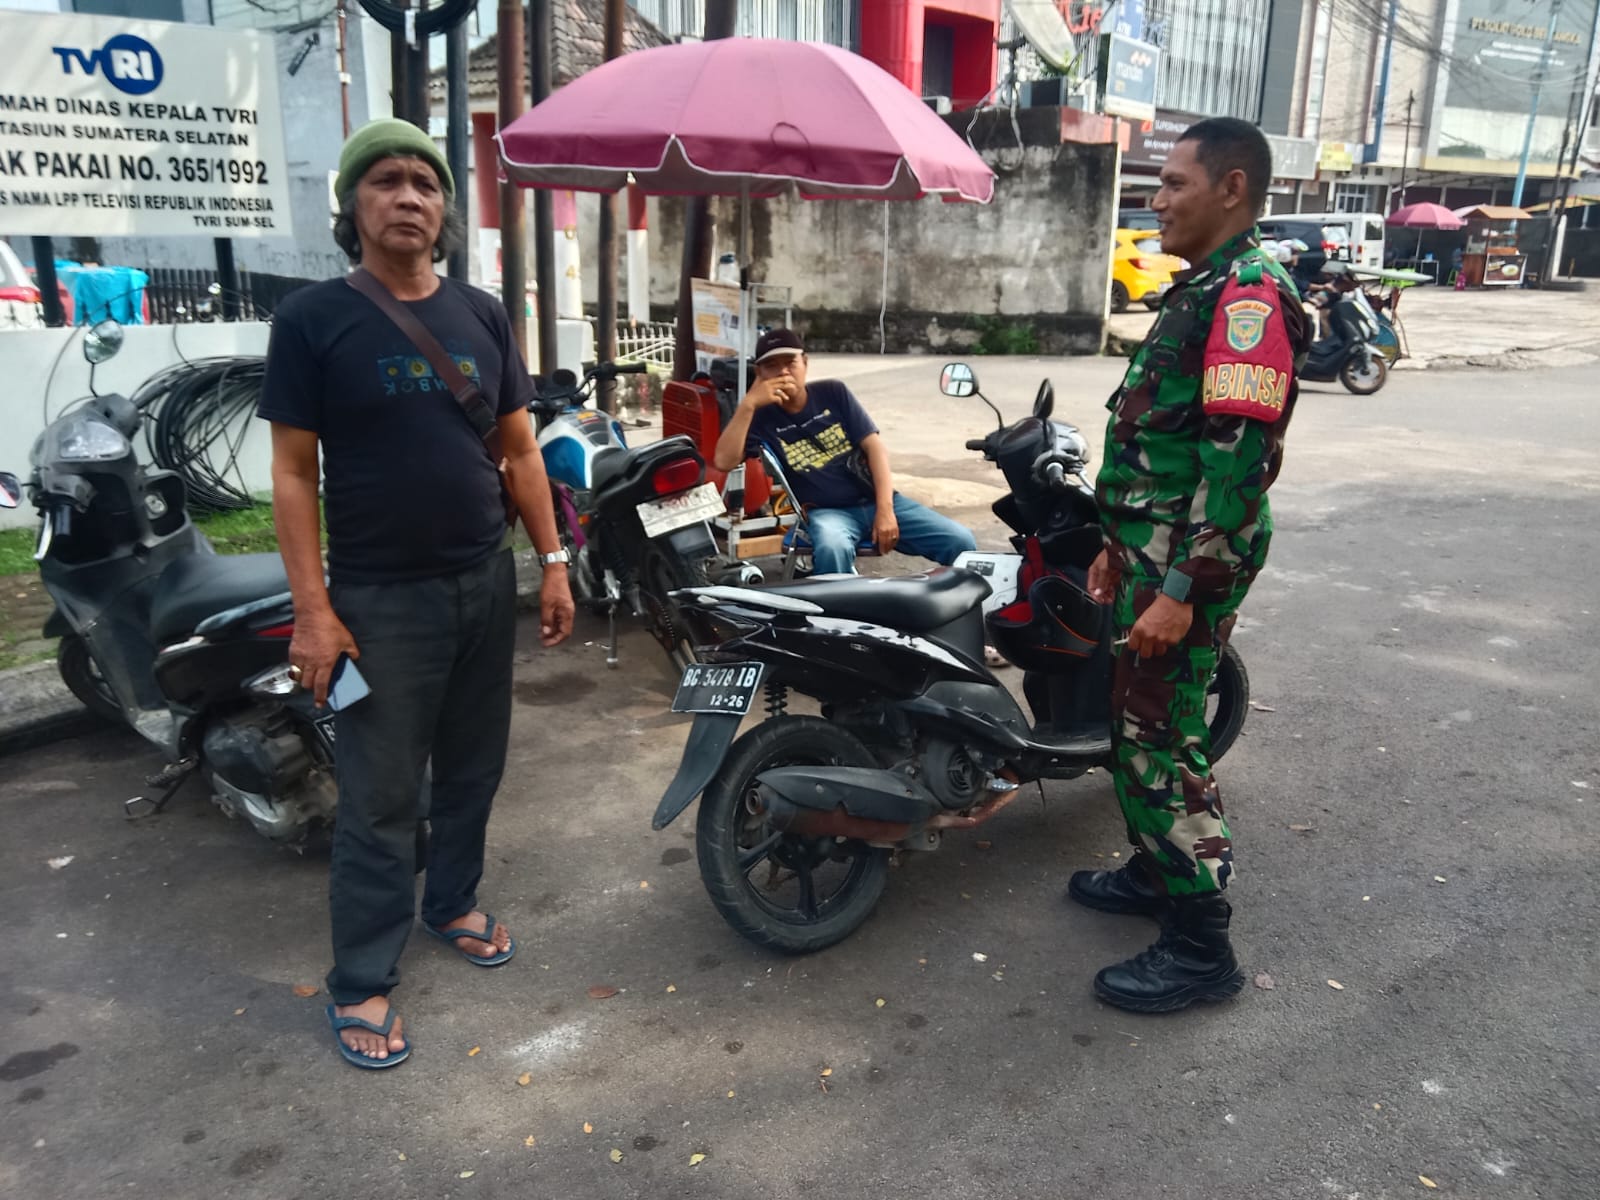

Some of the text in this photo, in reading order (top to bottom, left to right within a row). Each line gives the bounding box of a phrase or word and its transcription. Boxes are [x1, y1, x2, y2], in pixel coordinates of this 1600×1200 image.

[52, 44, 157, 84] TVRI
[0, 95, 258, 125] MAH DINAS KEPALA TVRI
[0, 121, 249, 147] TASIUN SUMATERA SELATAN
[35, 151, 111, 180] PAKAI
[119, 154, 162, 181] NO.
[168, 156, 269, 185] 365/1992
[11, 190, 52, 206] NAMA
[54, 192, 79, 208] LPP
[83, 193, 142, 209] TELEVISI
[144, 195, 206, 211] REPUBLIK
[209, 197, 274, 212] INDONESIA
[193, 215, 275, 229] TVRI SUM-SEL
[682, 667, 757, 688] BG 5478 IB
